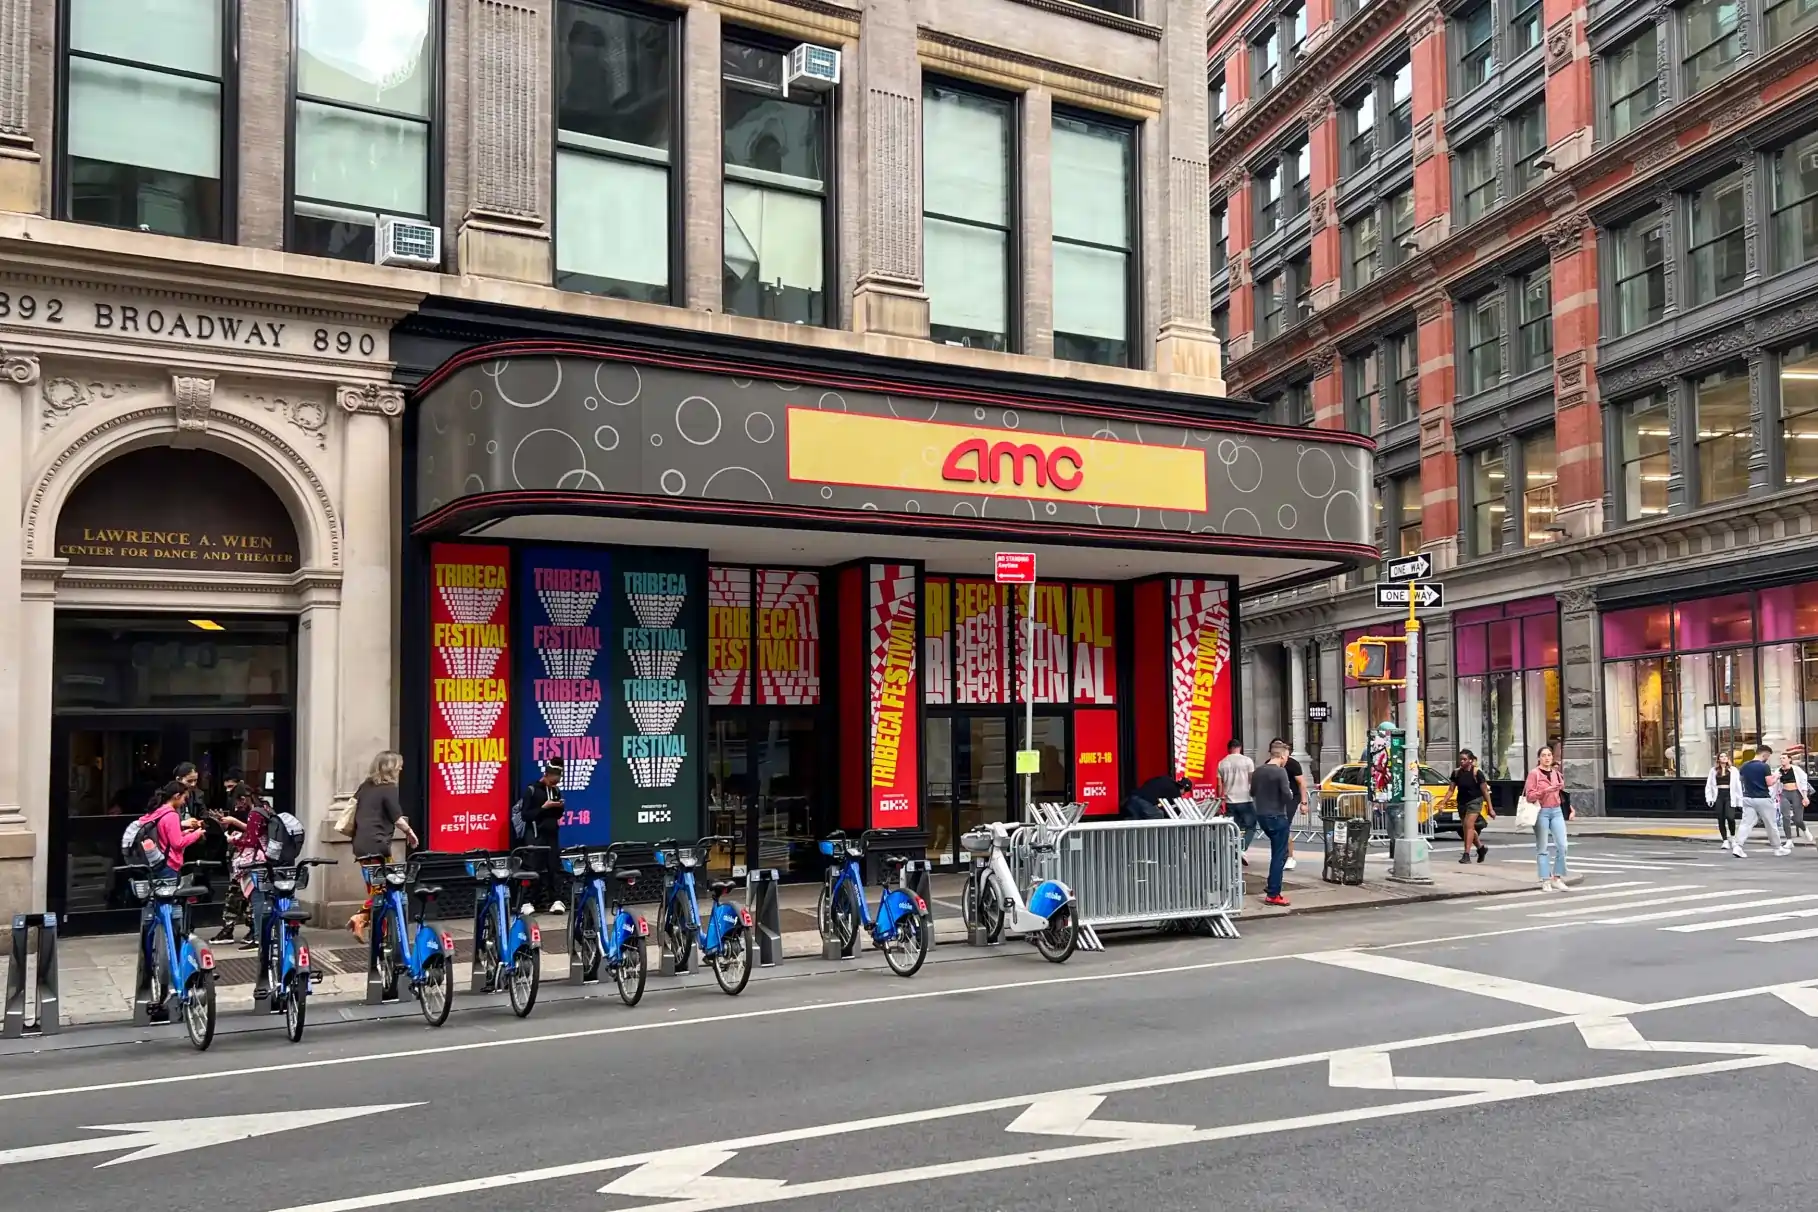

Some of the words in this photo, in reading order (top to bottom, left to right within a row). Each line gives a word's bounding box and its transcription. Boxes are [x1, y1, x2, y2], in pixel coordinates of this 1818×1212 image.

[0, 292, 63, 322] 892
[95, 302, 286, 348] BROADWAY
[313, 328, 376, 356] 890
[83, 528, 191, 546] LAWRENCE
[199, 535, 217, 547] A.
[222, 535, 273, 549] WIEN
[59, 545, 115, 556] CENTER
[120, 548, 149, 558] FOR
[154, 549, 198, 559] DANCE
[203, 551, 231, 561] AND
[235, 552, 293, 563] THEATER
[434, 563, 507, 589] TRIBECA
[533, 567, 602, 592] TRIBECA
[1393, 565, 1406, 576] ONE
[1411, 561, 1425, 573] WAY
[623, 571, 688, 596] TRIBECA
[1386, 591, 1405, 601] ONE
[1413, 591, 1433, 601] WAY
[434, 623, 507, 648] FESTIVAL
[708, 606, 798, 640] TRIBECA
[533, 625, 602, 650] FESTIVAL
[623, 627, 688, 651] FESTIVAL
[708, 638, 800, 671] FESTIVAL
[881, 619, 916, 709] FESTIVAL
[1192, 626, 1219, 709] FESTIVAL
[434, 678, 507, 702] TRIBECA
[533, 678, 602, 702] TRIBECA
[623, 678, 688, 702] TRIBECA
[433, 738, 507, 763] FESTIVAL
[532, 737, 602, 761] FESTIVAL
[622, 734, 688, 759] FESTIVAL
[871, 710, 903, 789] TRIBECA
[1184, 704, 1211, 779] TRIBECA
[1078, 752, 1097, 764] JUNE
